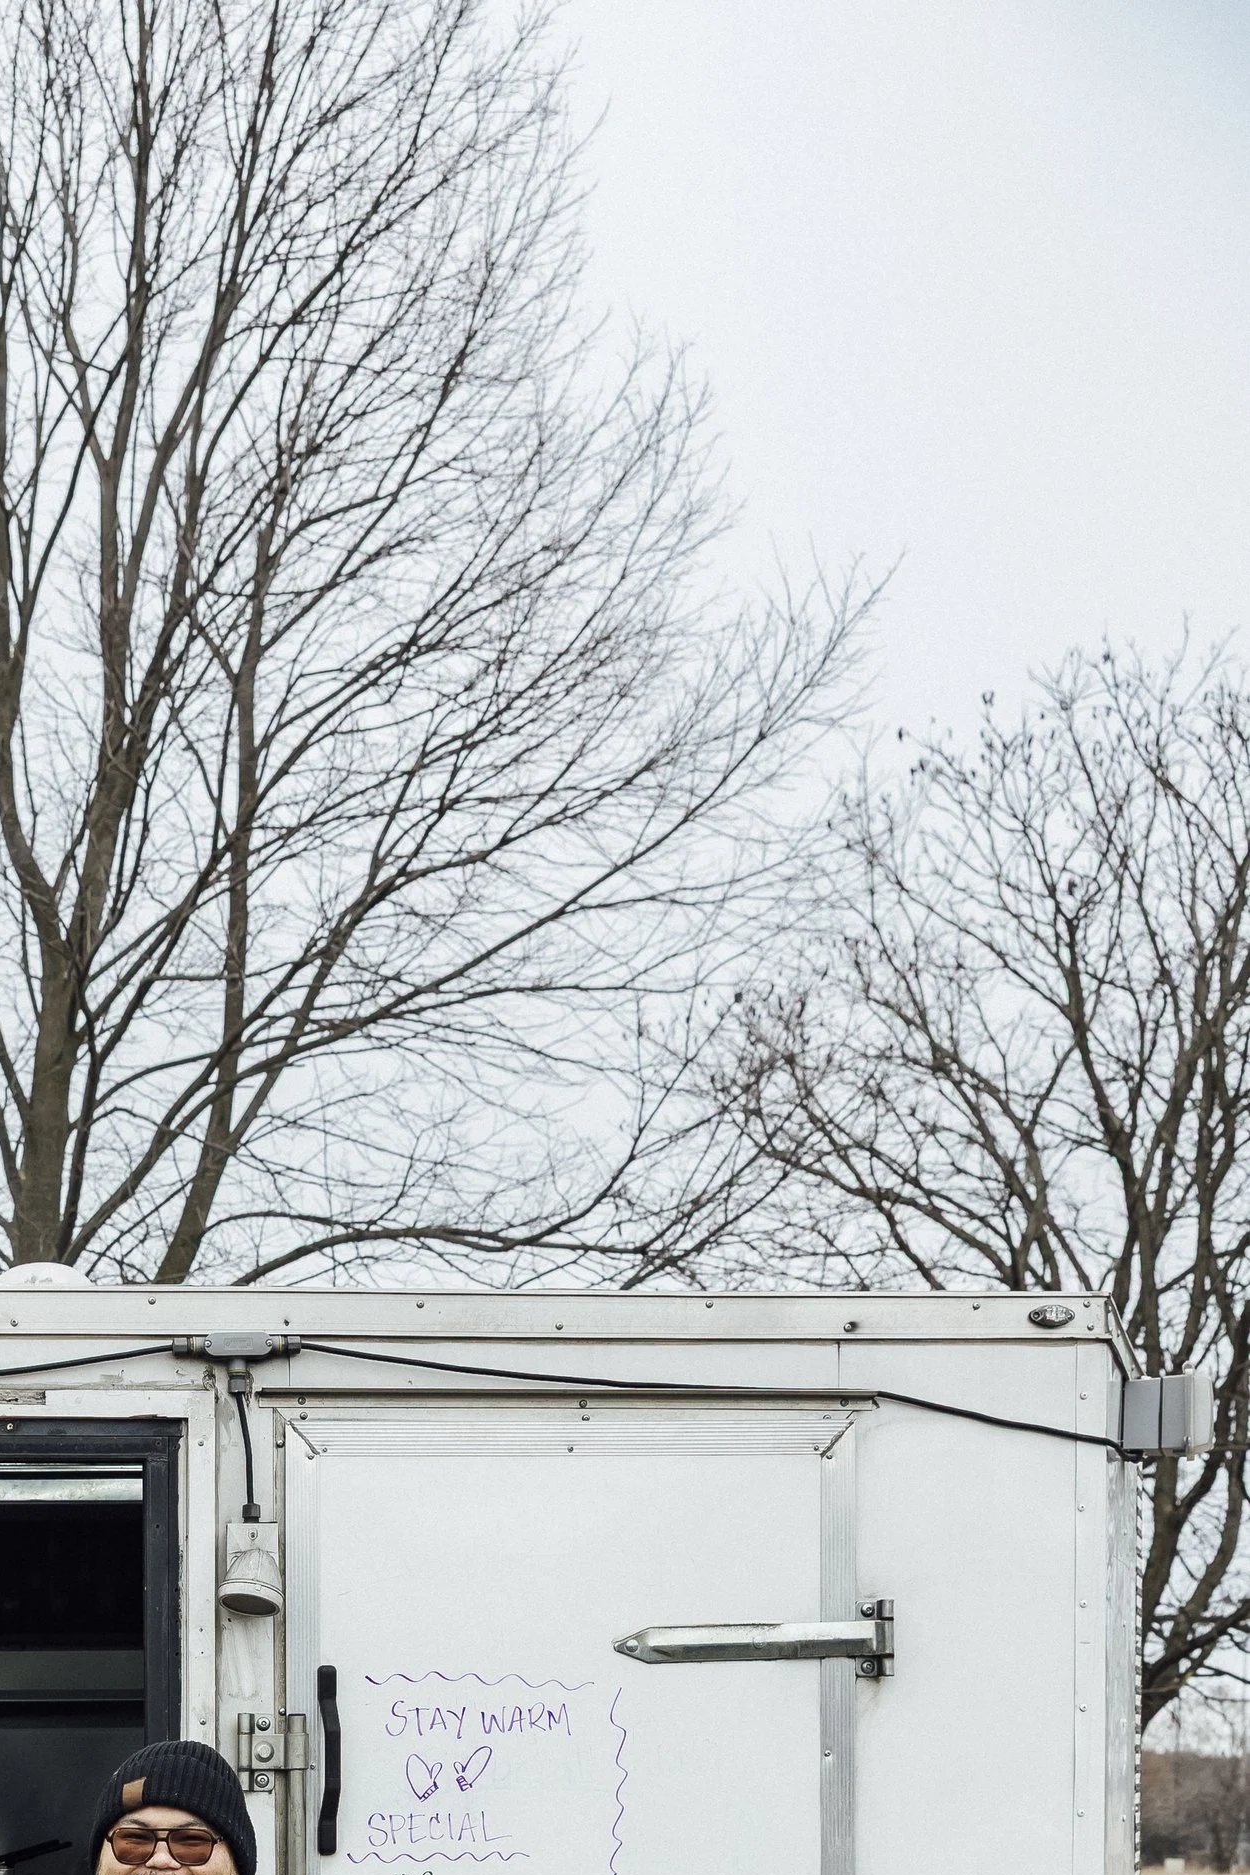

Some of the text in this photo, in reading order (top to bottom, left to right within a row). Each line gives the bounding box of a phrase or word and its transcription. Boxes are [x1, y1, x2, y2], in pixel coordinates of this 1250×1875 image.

[385, 1700, 573, 1740] STAY WARM
[367, 1811, 513, 1847] SPECIAL
